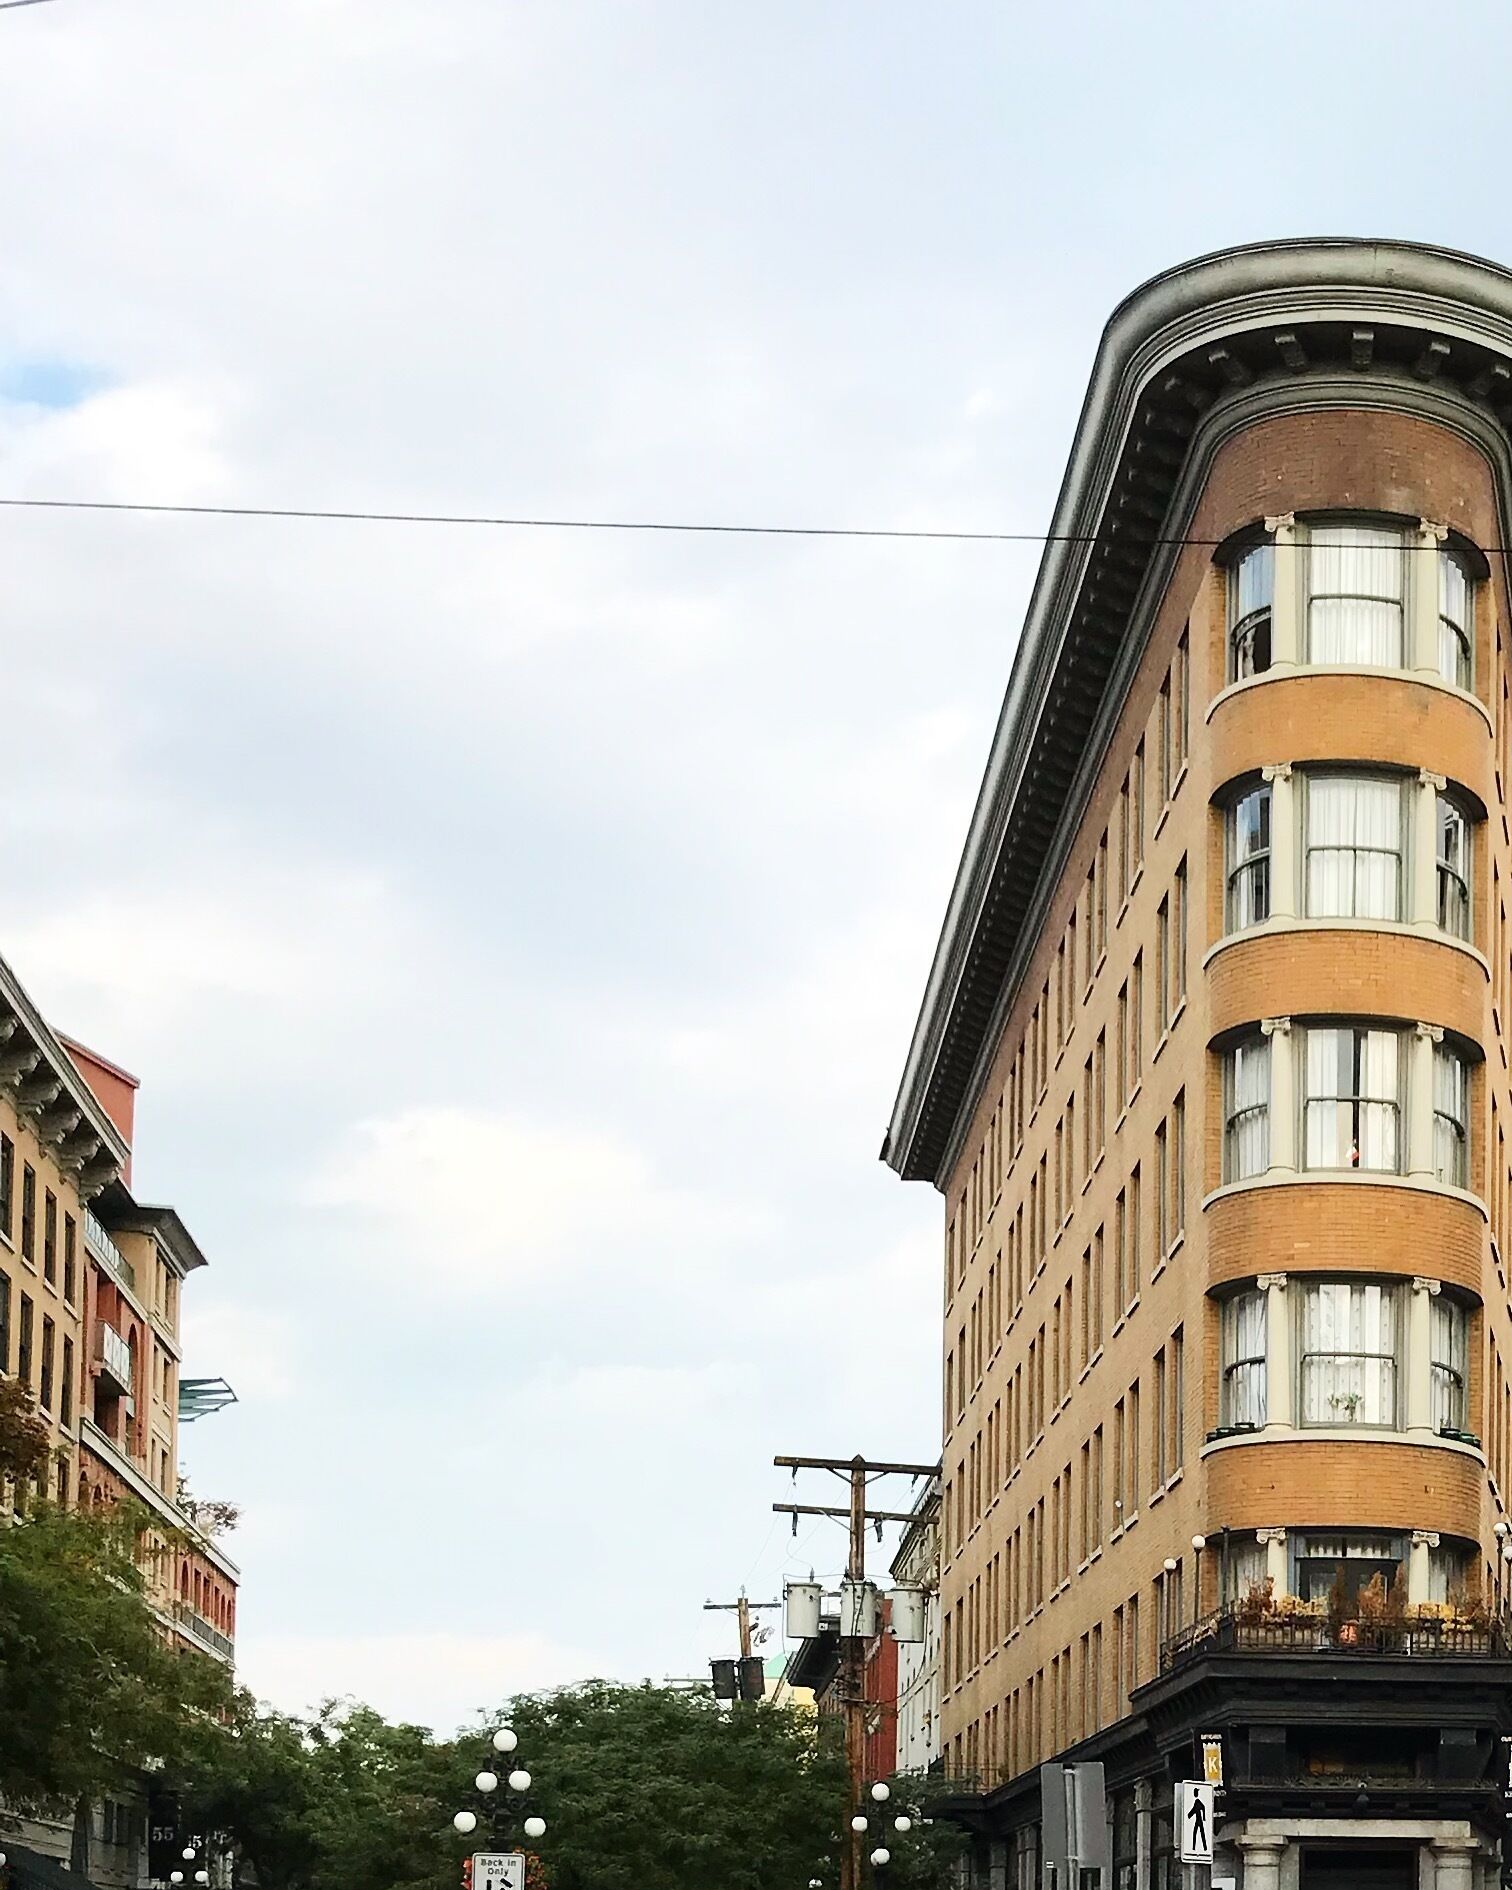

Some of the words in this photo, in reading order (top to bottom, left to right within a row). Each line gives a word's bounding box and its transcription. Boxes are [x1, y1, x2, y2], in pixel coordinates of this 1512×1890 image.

[1208, 1757, 1218, 1773] K
[153, 1827, 173, 1841] 55
[481, 1859, 503, 1867] Back
[487, 1867, 509, 1877] Only
